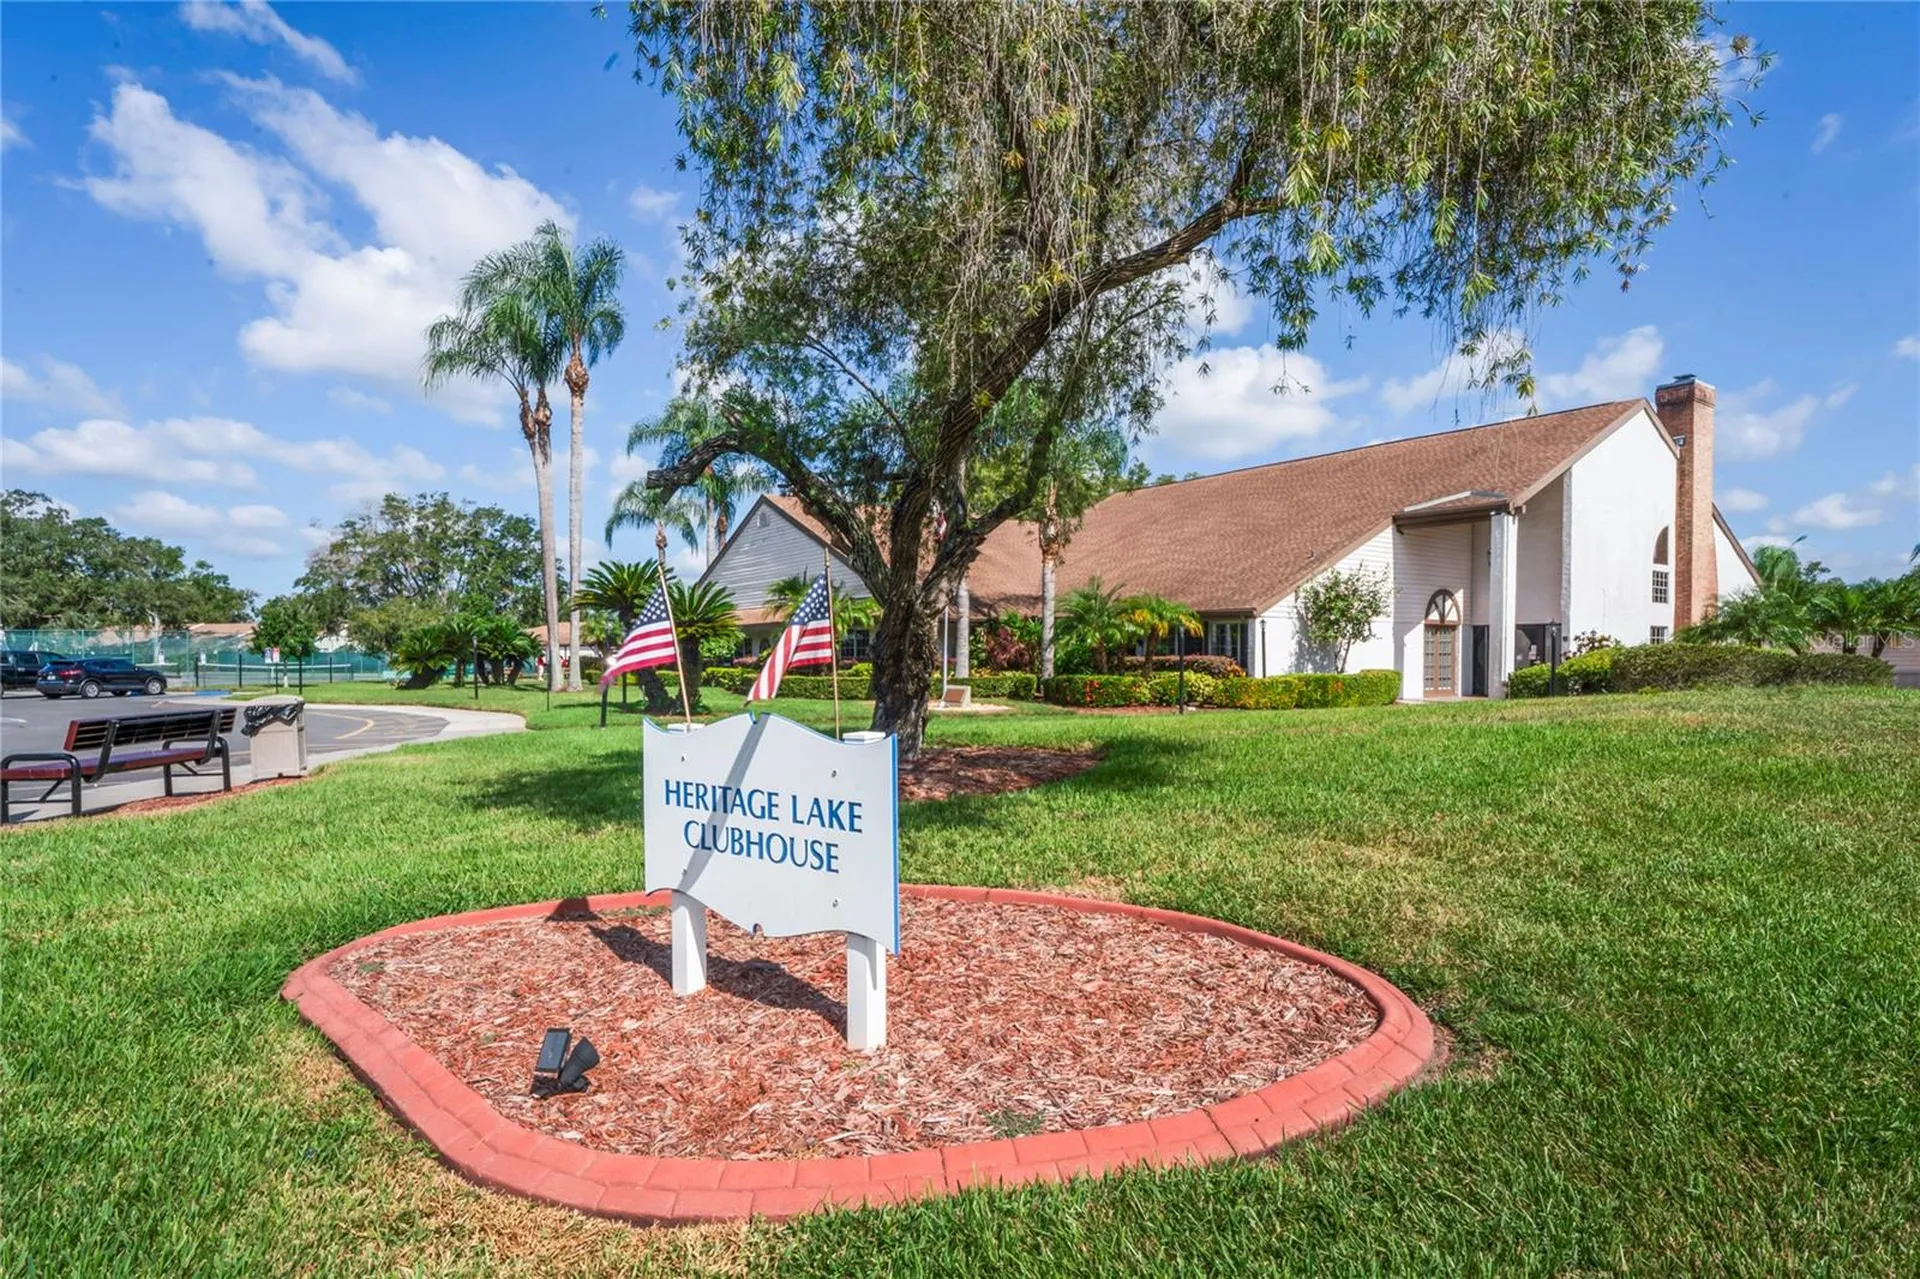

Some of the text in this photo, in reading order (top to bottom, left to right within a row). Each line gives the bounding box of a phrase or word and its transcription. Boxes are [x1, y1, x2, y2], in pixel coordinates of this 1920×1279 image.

[664, 779, 863, 834] HERITAGE LAKE
[683, 820, 839, 874] CLUBHOUSE
